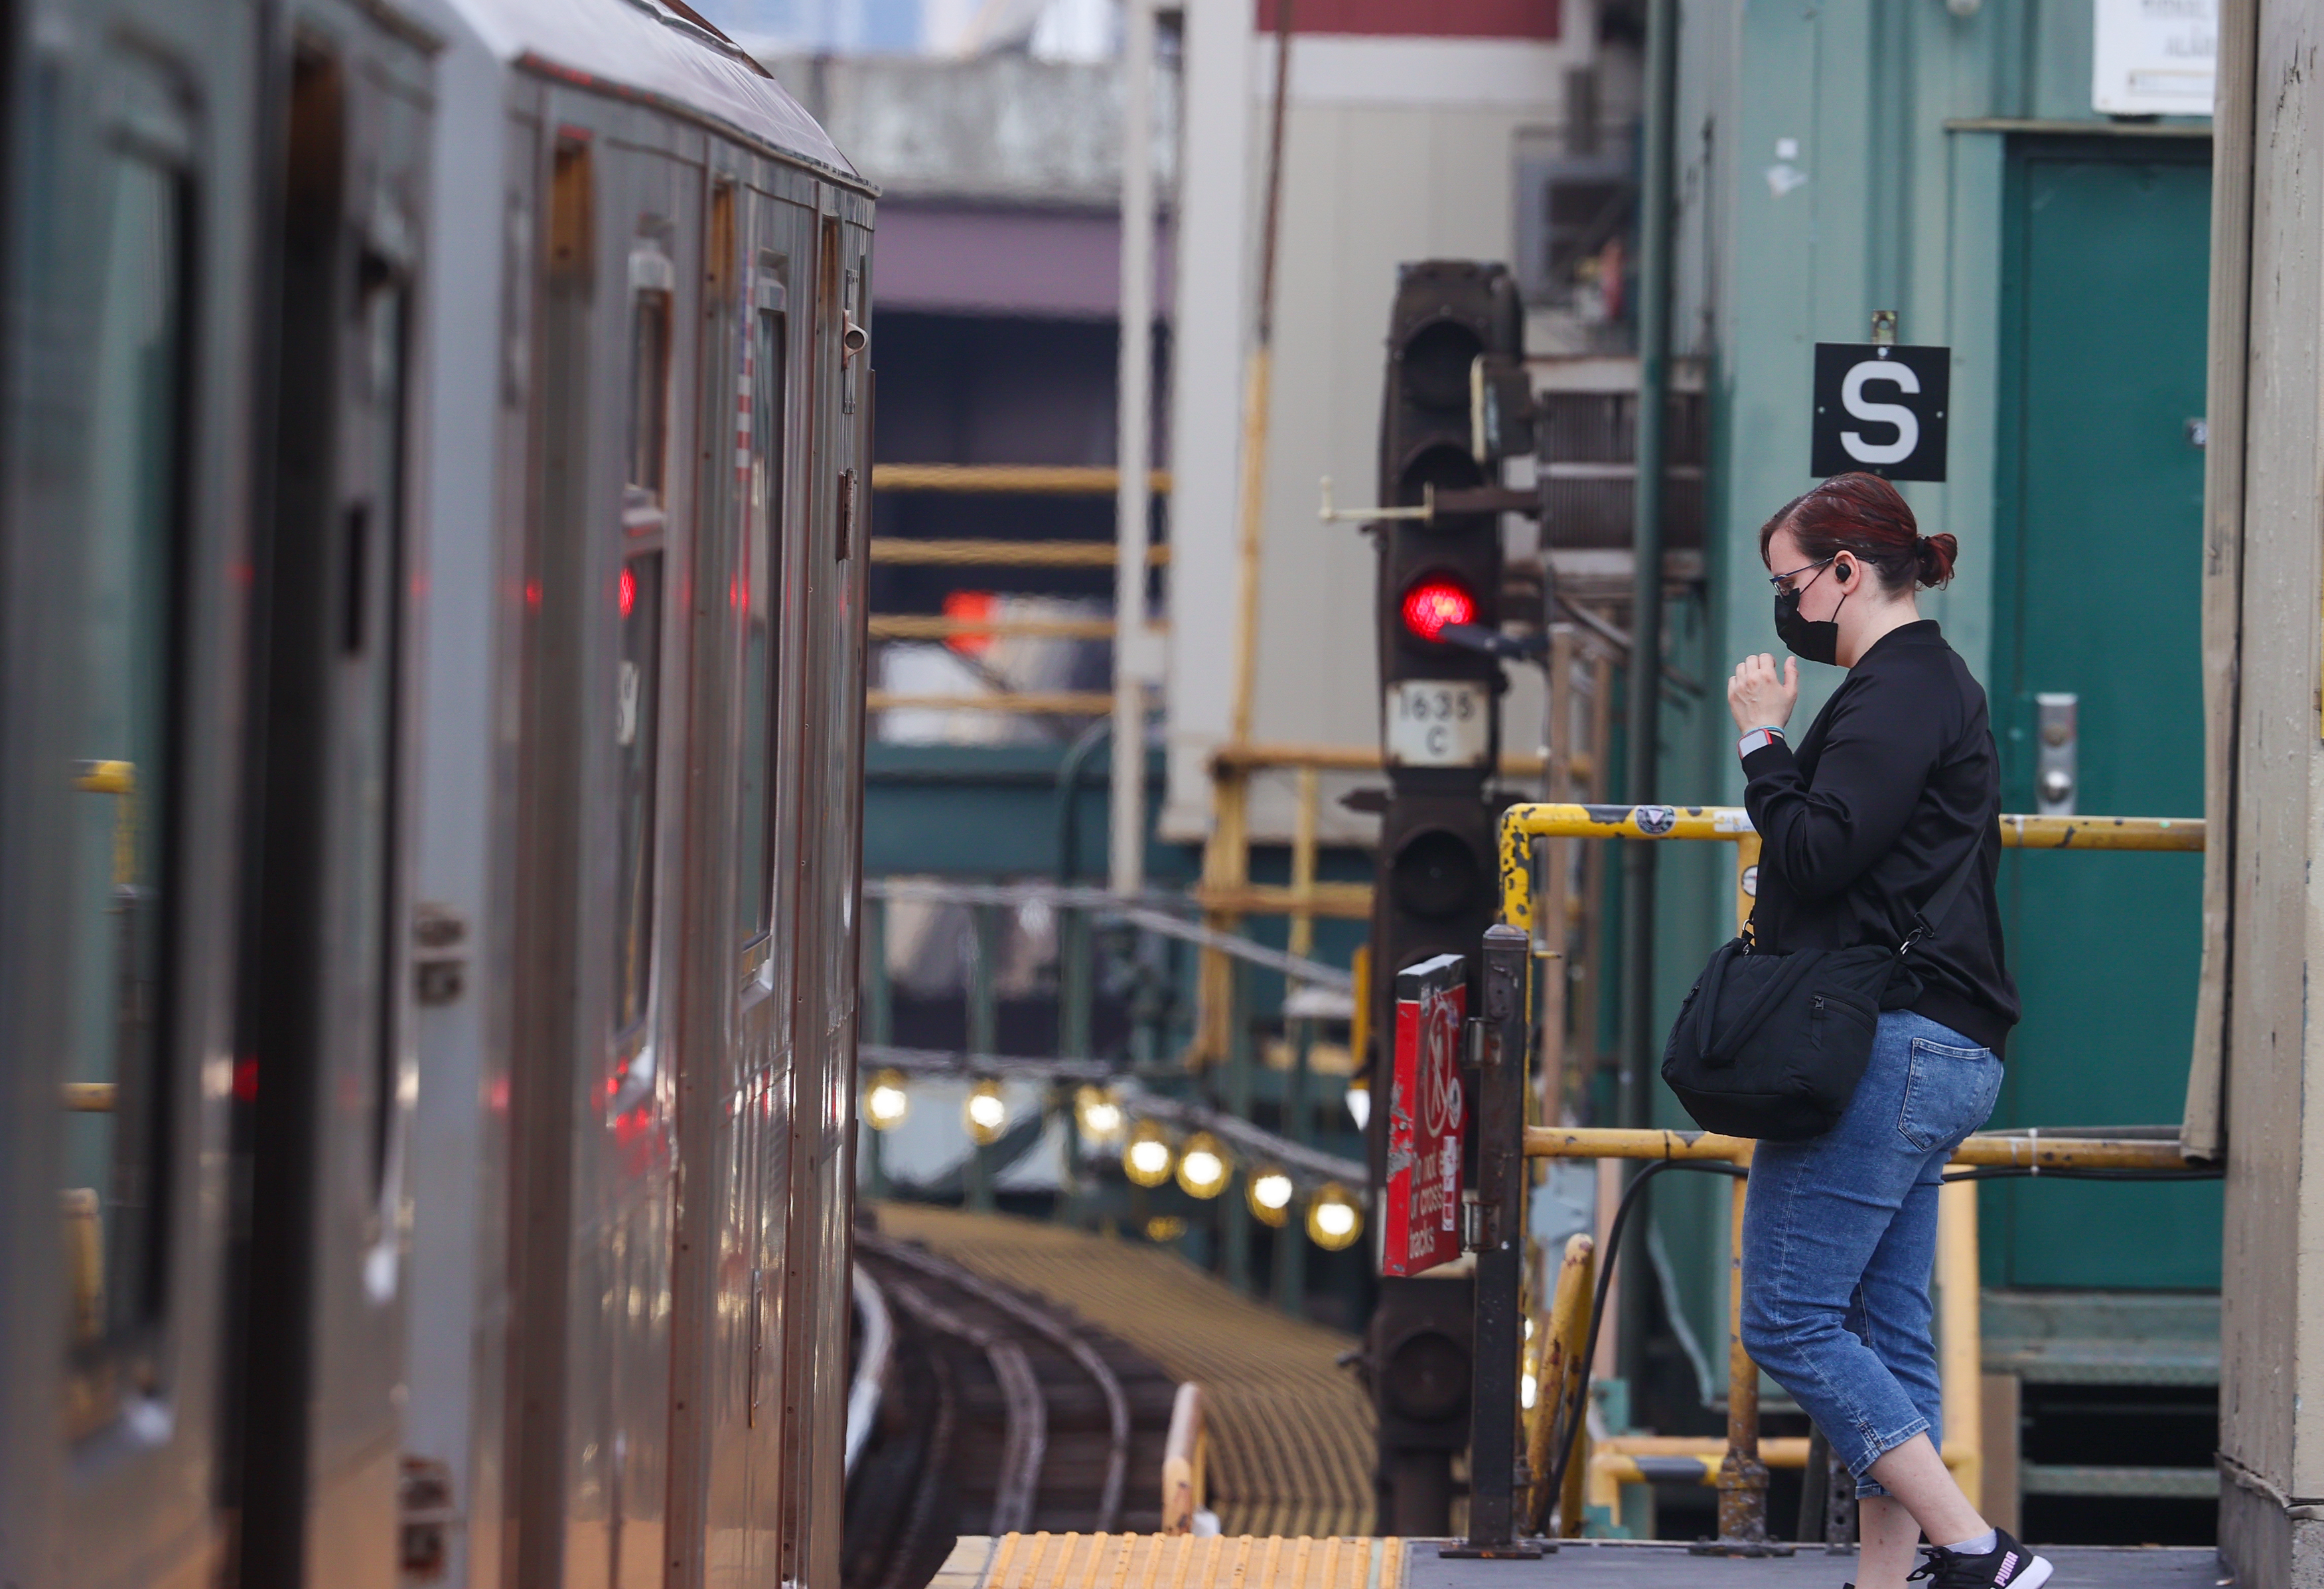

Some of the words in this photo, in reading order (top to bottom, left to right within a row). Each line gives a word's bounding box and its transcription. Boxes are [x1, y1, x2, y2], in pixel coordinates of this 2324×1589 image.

[1840, 360, 1921, 464] S
[1400, 690, 1473, 721] 1635
[1426, 725, 1448, 756] C
[1423, 1146, 1437, 1181] not
[1411, 1193, 1419, 1220] or
[1420, 1183, 1443, 1216] cross
[1409, 1219, 1435, 1259] tracks
[1994, 1551, 2019, 1587] PUMA
